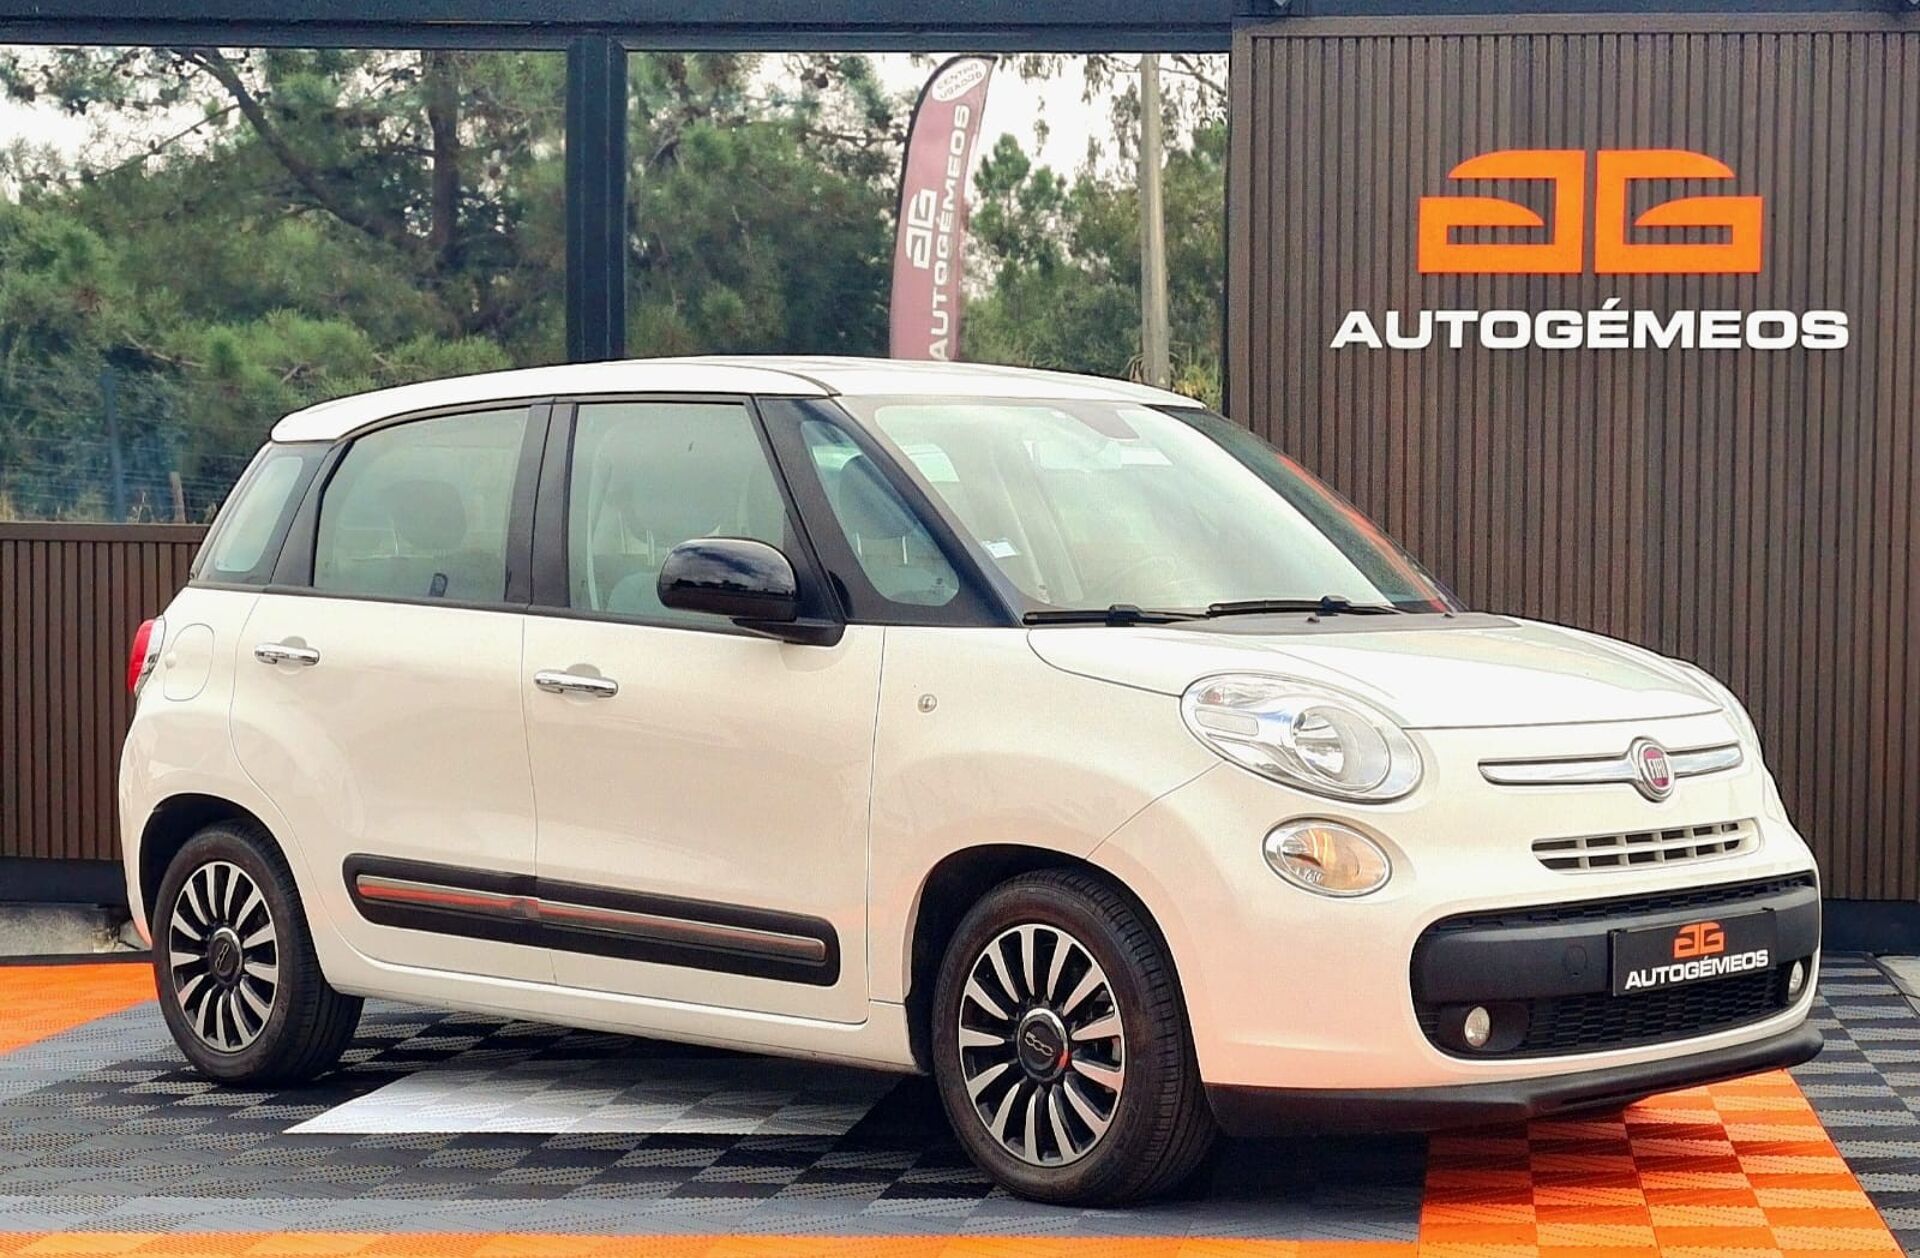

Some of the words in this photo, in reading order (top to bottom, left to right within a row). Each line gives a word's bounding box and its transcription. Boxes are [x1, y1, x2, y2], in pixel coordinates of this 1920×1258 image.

[929, 104, 970, 361] AUTOGÉMEOS
[1330, 298, 1849, 350] AUTOGÉMEOS
[1625, 949, 1769, 990] AUTOGÉMEOS
